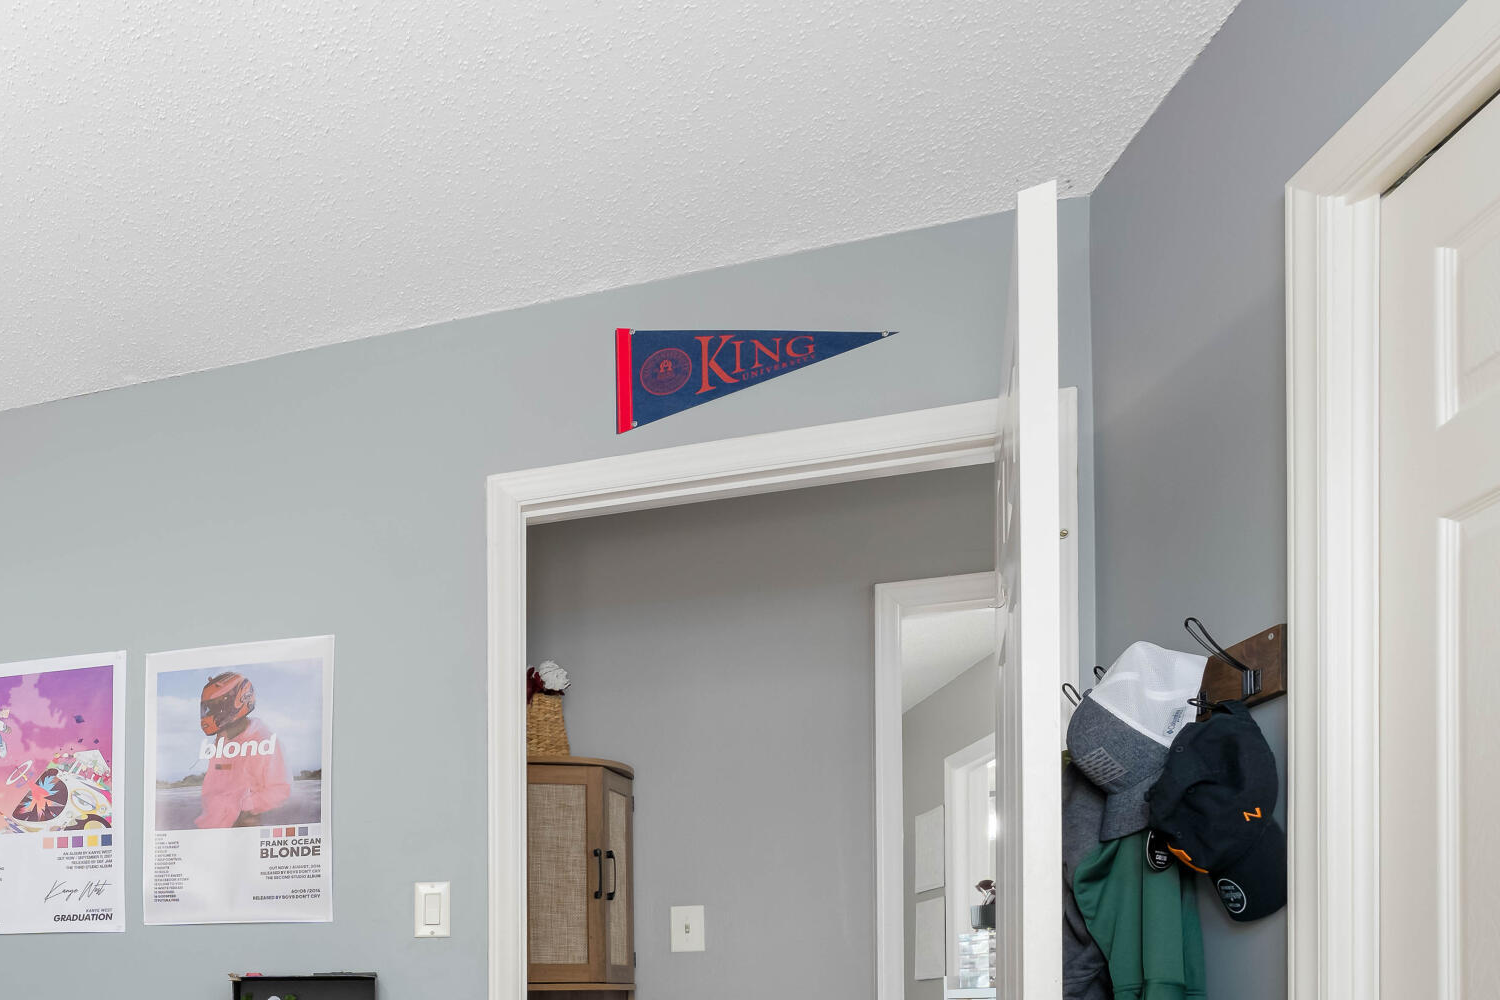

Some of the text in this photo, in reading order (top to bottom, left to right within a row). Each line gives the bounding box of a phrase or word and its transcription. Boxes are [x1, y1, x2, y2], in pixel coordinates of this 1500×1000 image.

[695, 335, 815, 395] KING
[199, 733, 277, 760] blond
[260, 845, 321, 858] BLONDE
[53, 913, 113, 922] GRADUATION
